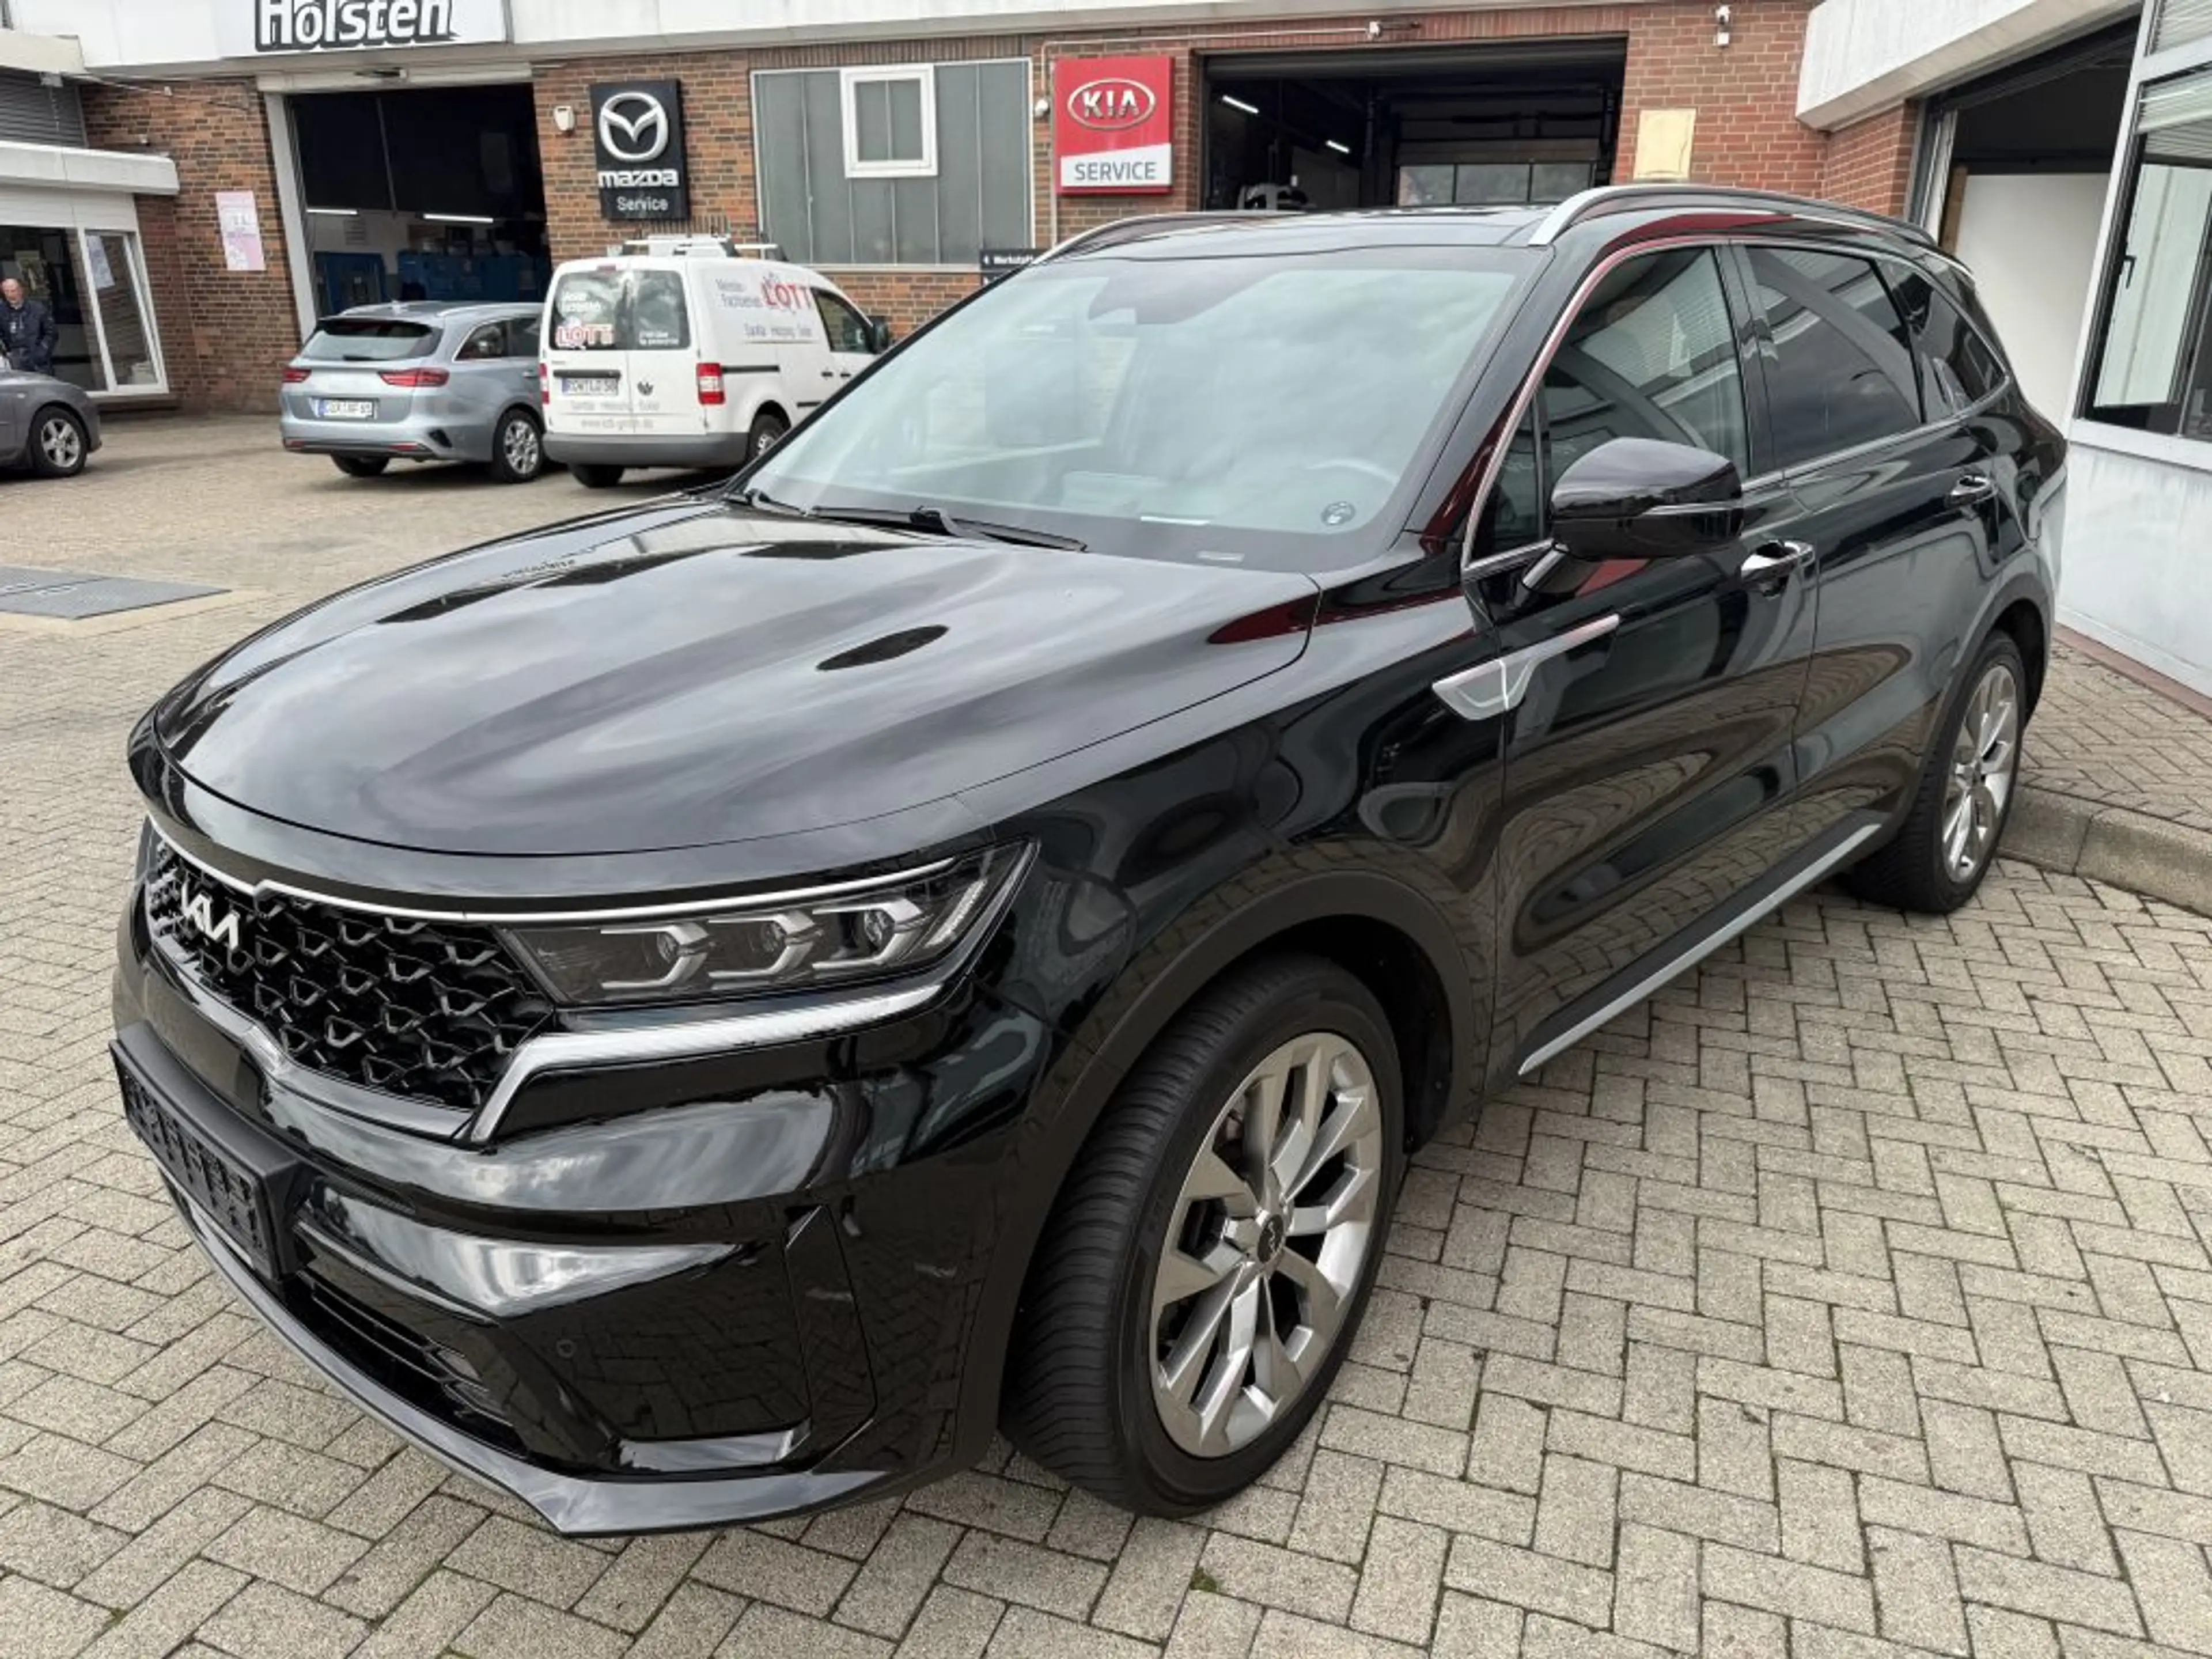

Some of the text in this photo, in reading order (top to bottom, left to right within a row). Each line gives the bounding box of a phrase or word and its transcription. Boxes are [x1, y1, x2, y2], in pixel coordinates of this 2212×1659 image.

[256, 0, 458, 51] Holsten
[1082, 90, 1141, 119] KIA
[597, 169, 680, 188] mazda
[1074, 161, 1157, 181] SERVICE
[616, 196, 669, 211] Service
[181, 881, 240, 950] KIA
